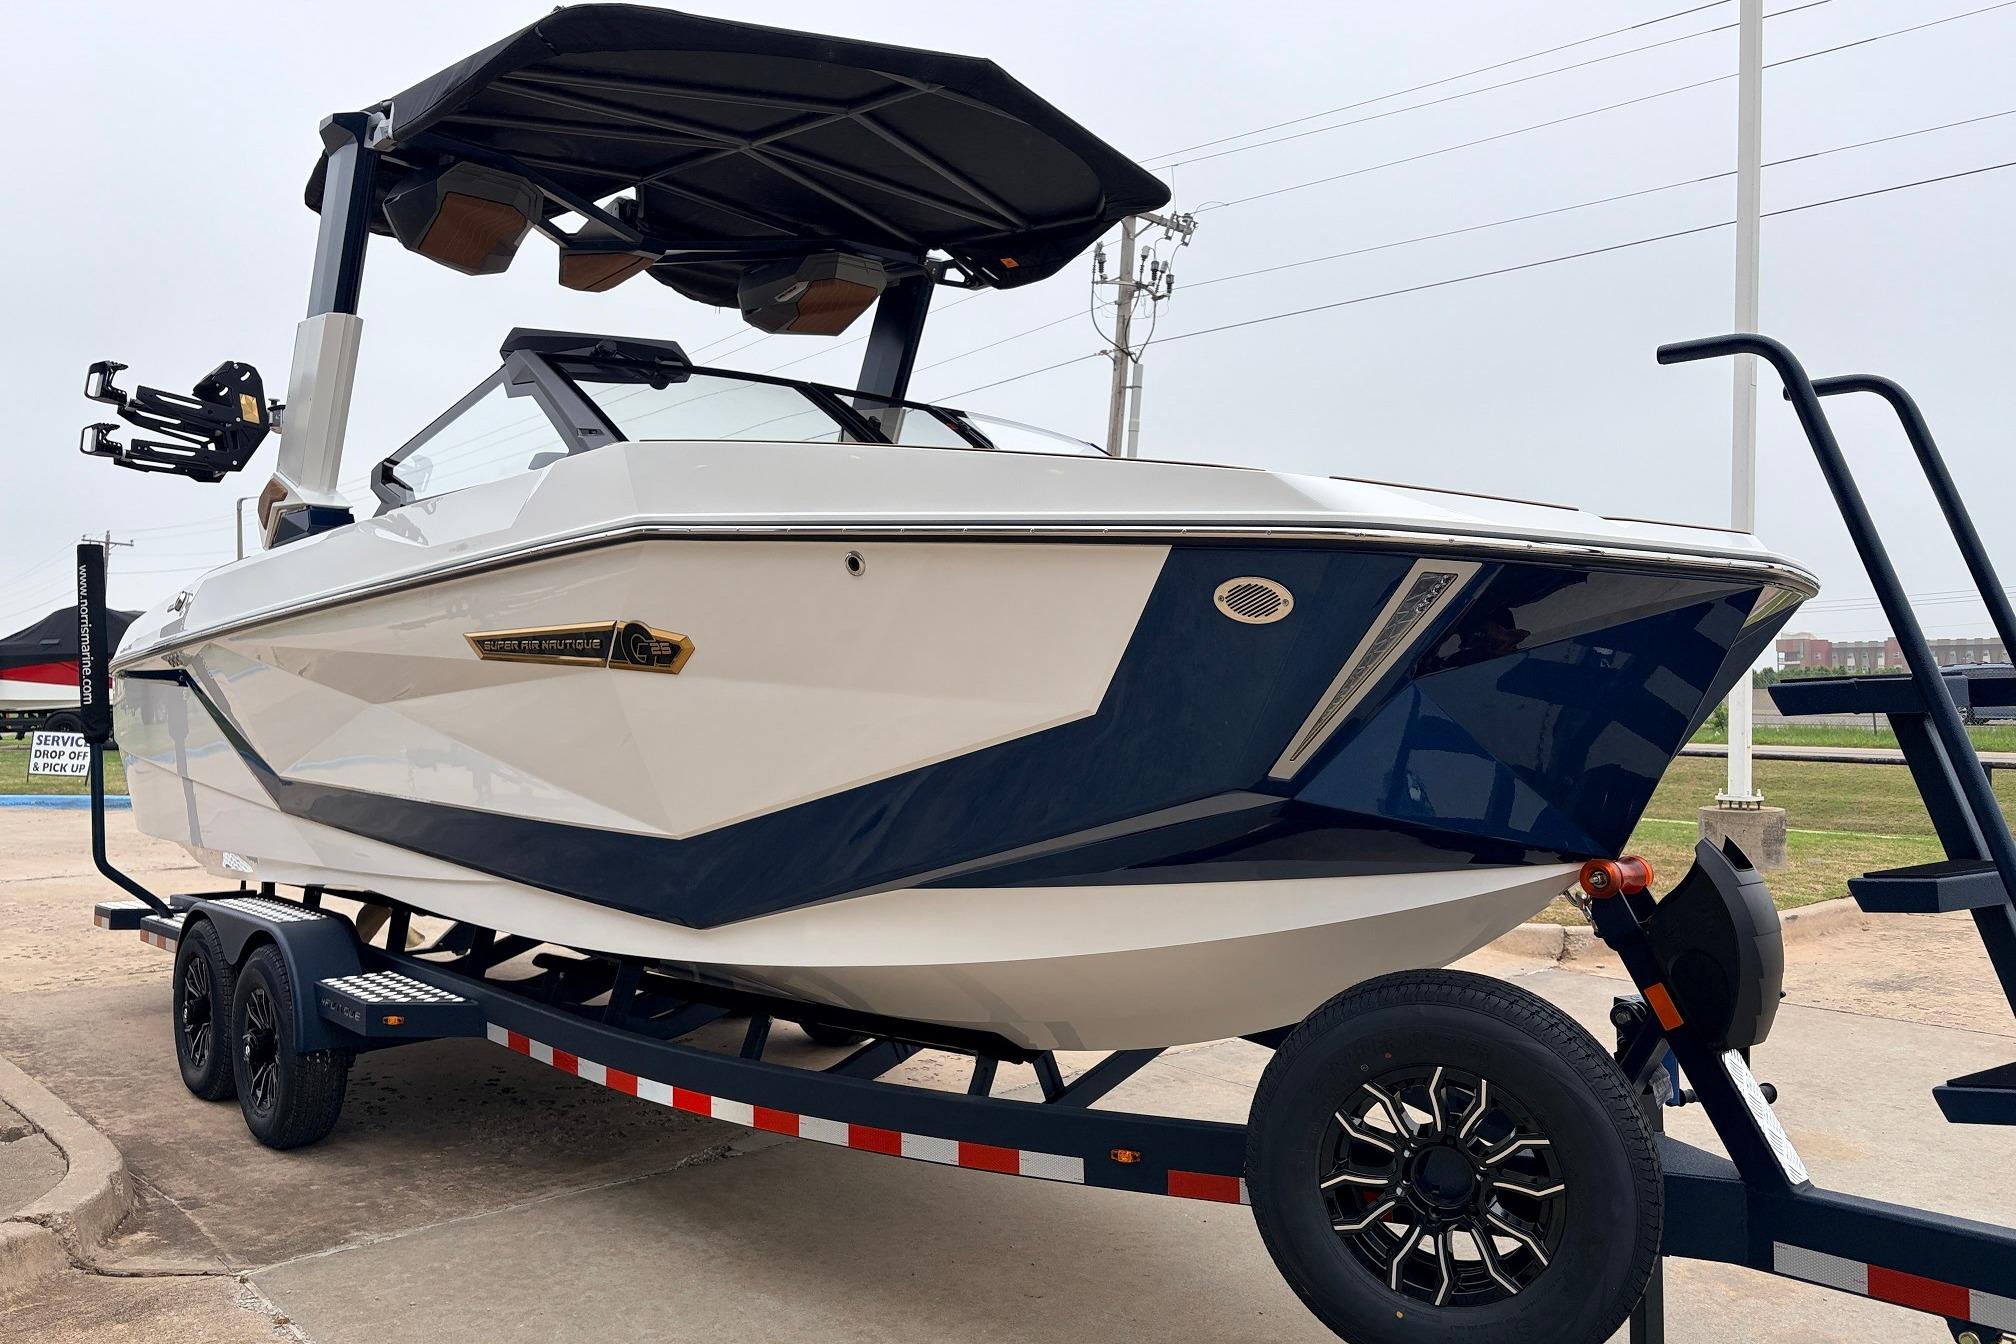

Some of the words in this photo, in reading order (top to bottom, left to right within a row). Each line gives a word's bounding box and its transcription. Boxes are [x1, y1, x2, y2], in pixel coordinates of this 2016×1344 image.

[79, 565, 93, 704] www.norrismarine.com
[484, 641, 519, 651] SUPER
[521, 640, 540, 650] AIR
[541, 639, 601, 650] NAUTIQUE
[34, 749, 65, 760] DROP
[68, 750, 89, 761] OFF
[32, 761, 39, 772] &
[42, 762, 69, 773] PICK
[70, 763, 86, 774] UP
